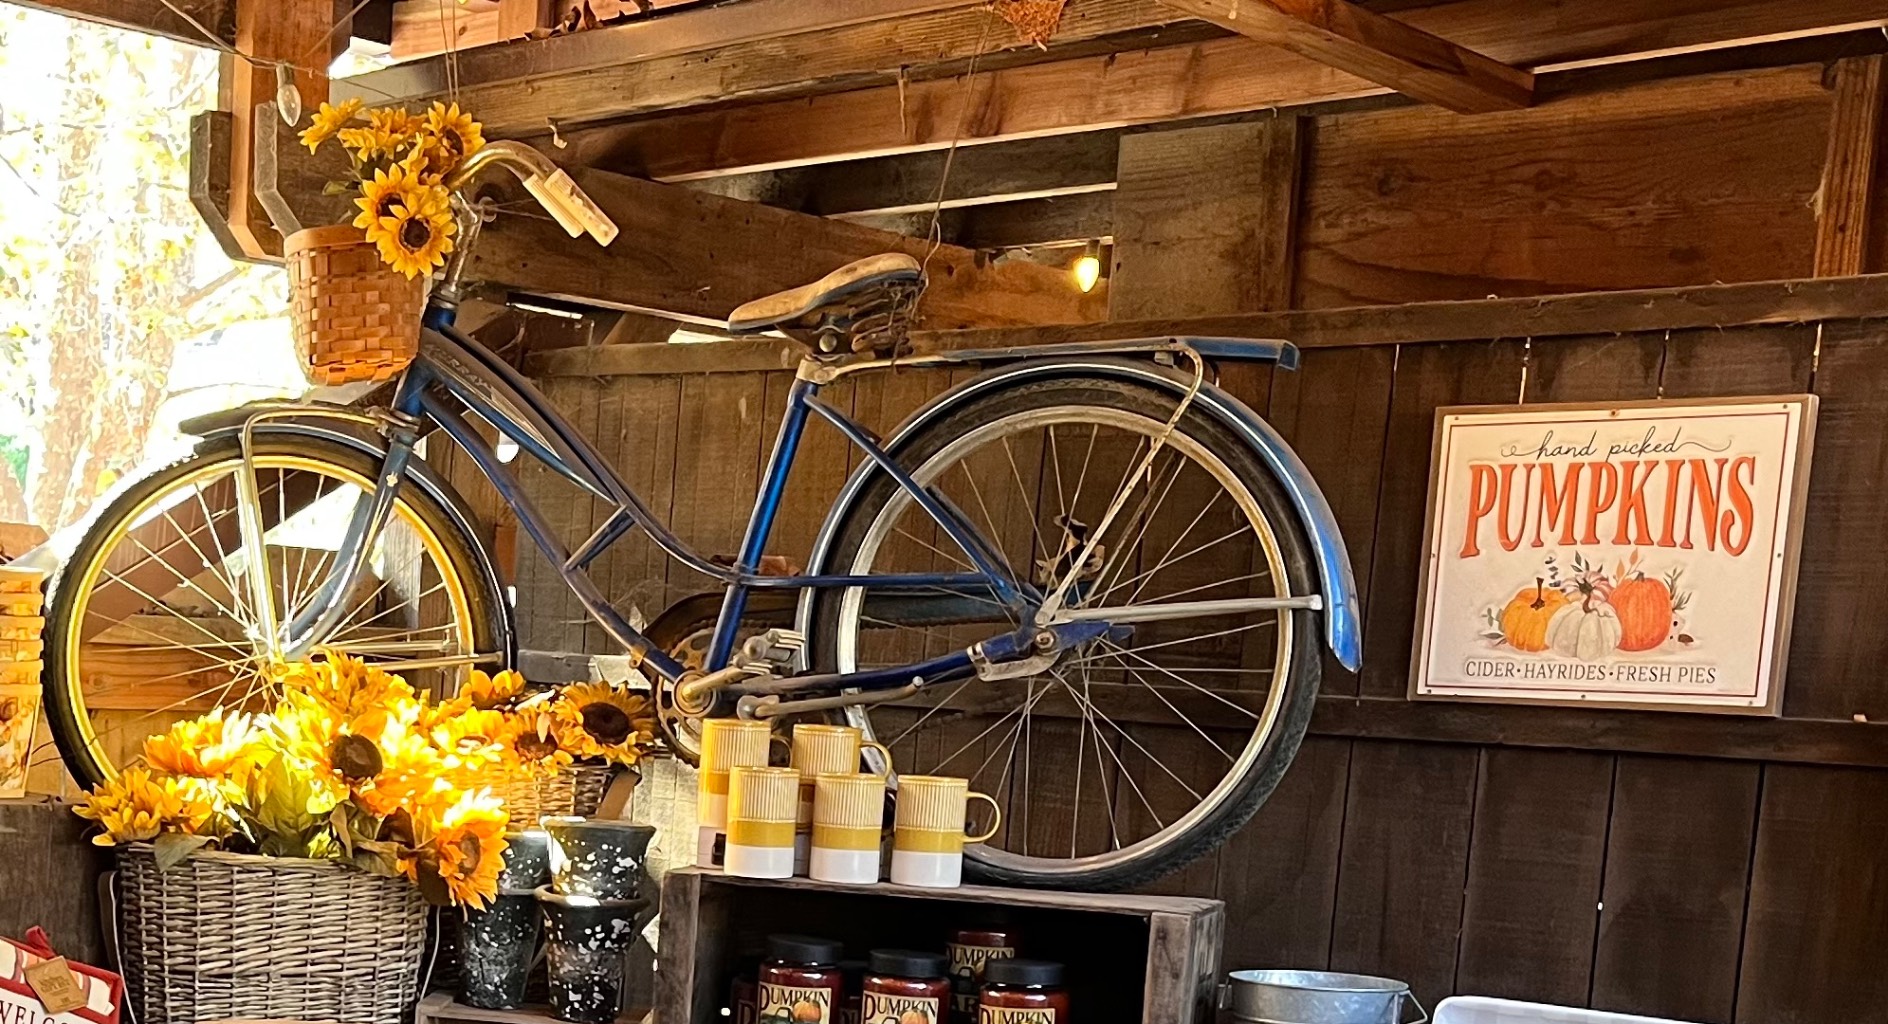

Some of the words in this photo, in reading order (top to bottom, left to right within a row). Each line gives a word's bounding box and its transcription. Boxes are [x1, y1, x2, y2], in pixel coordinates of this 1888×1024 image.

[1501, 430, 1598, 460] hand
[1606, 426, 1732, 463] picked
[1460, 456, 1756, 559] PUMPKINS
[1465, 660, 1516, 678] CIDER
[1523, 662, 1607, 682] HAYRIDES
[1615, 665, 1672, 684] FRESH
[1677, 666, 1716, 684] PIES
